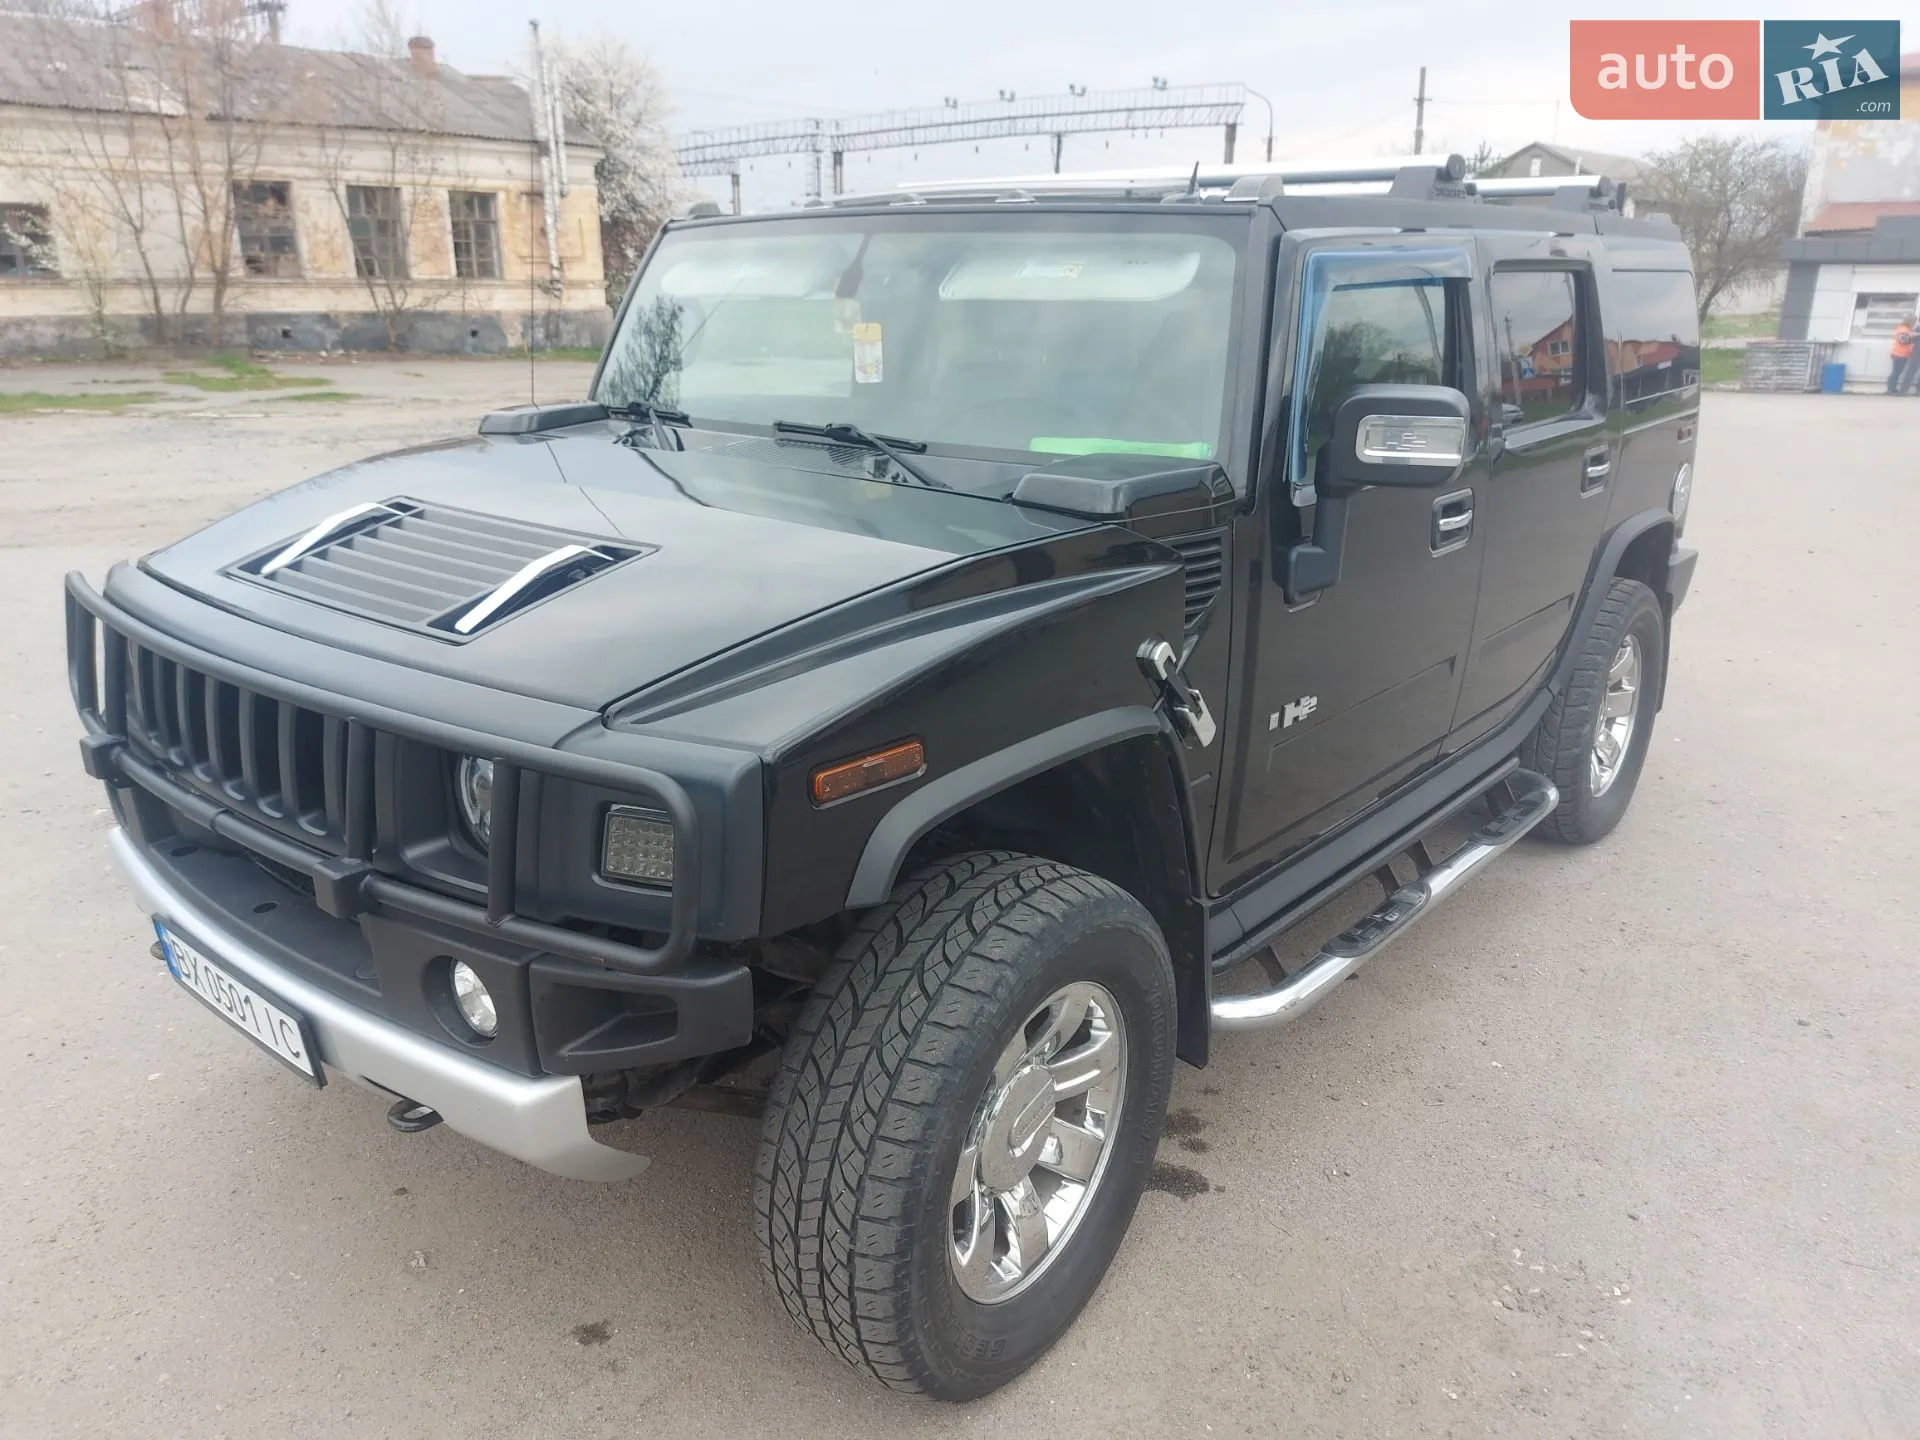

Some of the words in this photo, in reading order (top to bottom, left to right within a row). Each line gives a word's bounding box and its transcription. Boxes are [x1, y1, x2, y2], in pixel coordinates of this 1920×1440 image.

[171, 938, 206, 994] BX
[204, 965, 261, 1034] 0501
[264, 1006, 301, 1059] IC
